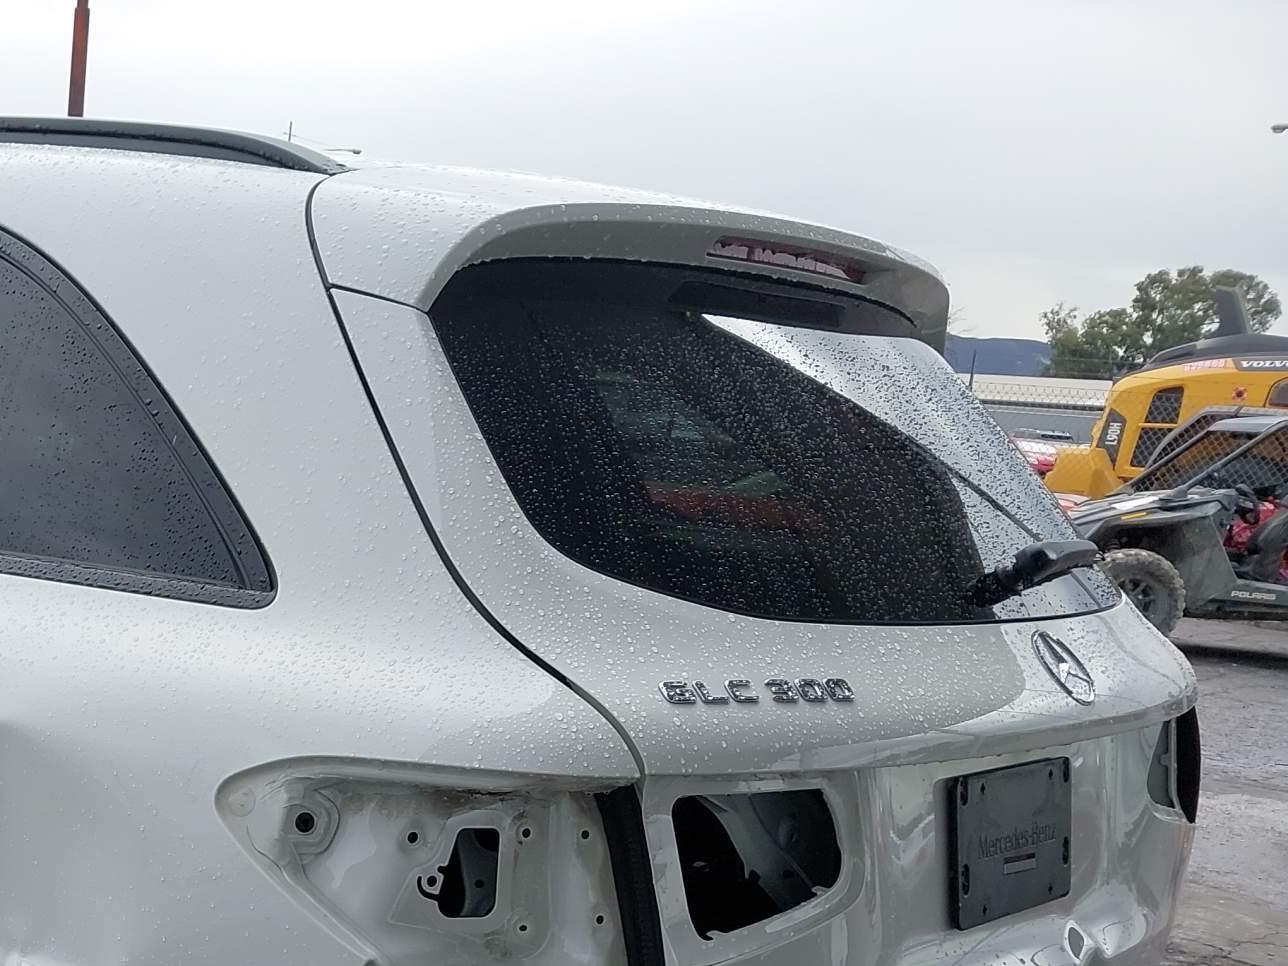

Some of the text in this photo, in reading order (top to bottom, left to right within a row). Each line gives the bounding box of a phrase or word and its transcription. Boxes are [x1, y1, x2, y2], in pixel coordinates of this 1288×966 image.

[1241, 360, 1288, 368] VOLV
[1105, 422, 1123, 446] L90H
[1231, 590, 1277, 600] POLARIS
[657, 678, 855, 703] GLC 300
[980, 820, 1056, 858] Mercedes-Benz
